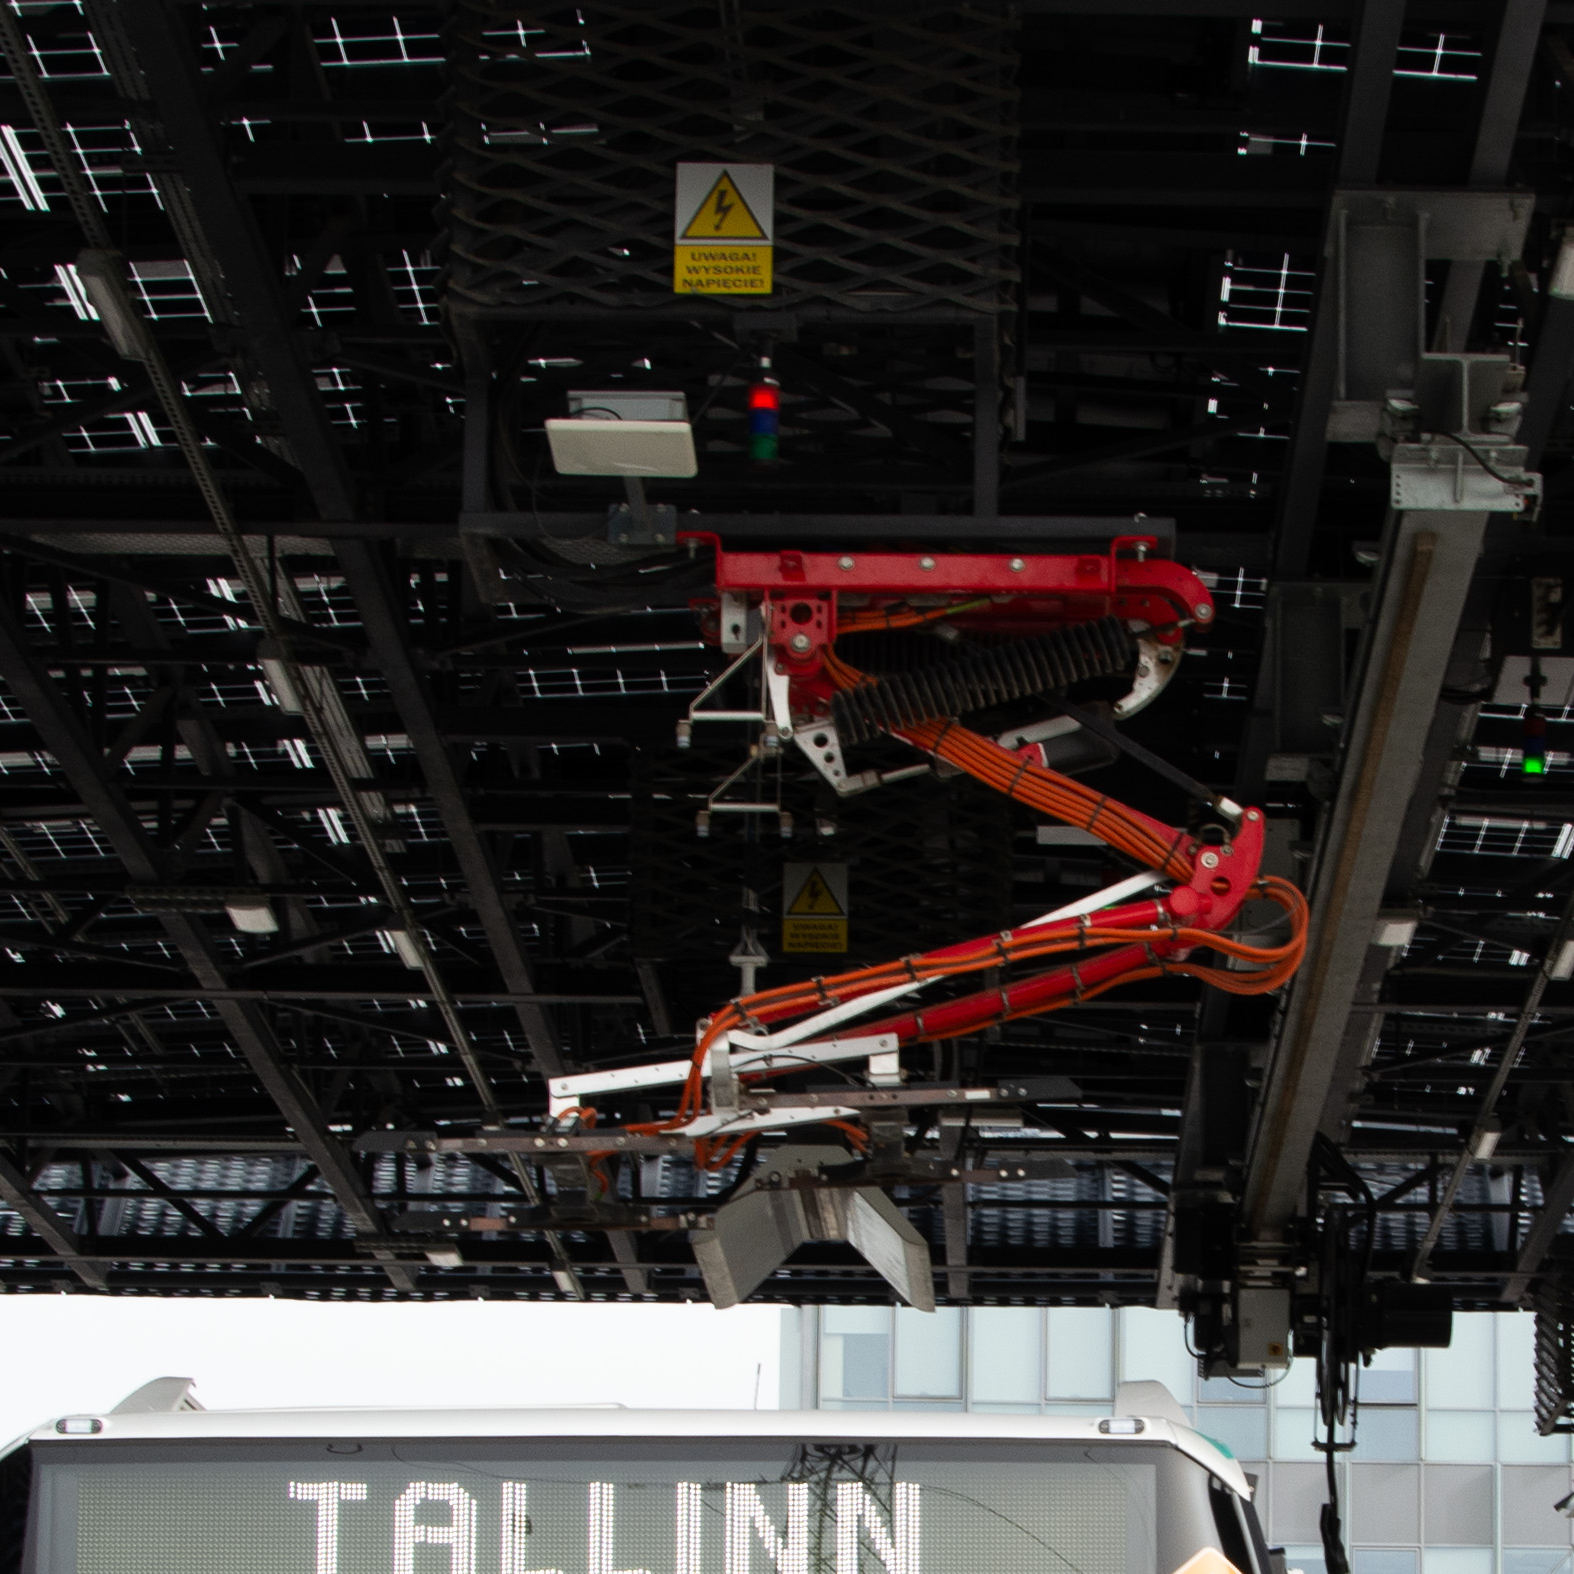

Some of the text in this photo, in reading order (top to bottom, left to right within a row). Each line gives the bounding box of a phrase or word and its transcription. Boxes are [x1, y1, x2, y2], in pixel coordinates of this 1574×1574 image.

[691, 251, 757, 262] UWAGA!
[686, 265, 762, 275] WYSOKIE
[682, 278, 765, 289] NAPIĘCIE!
